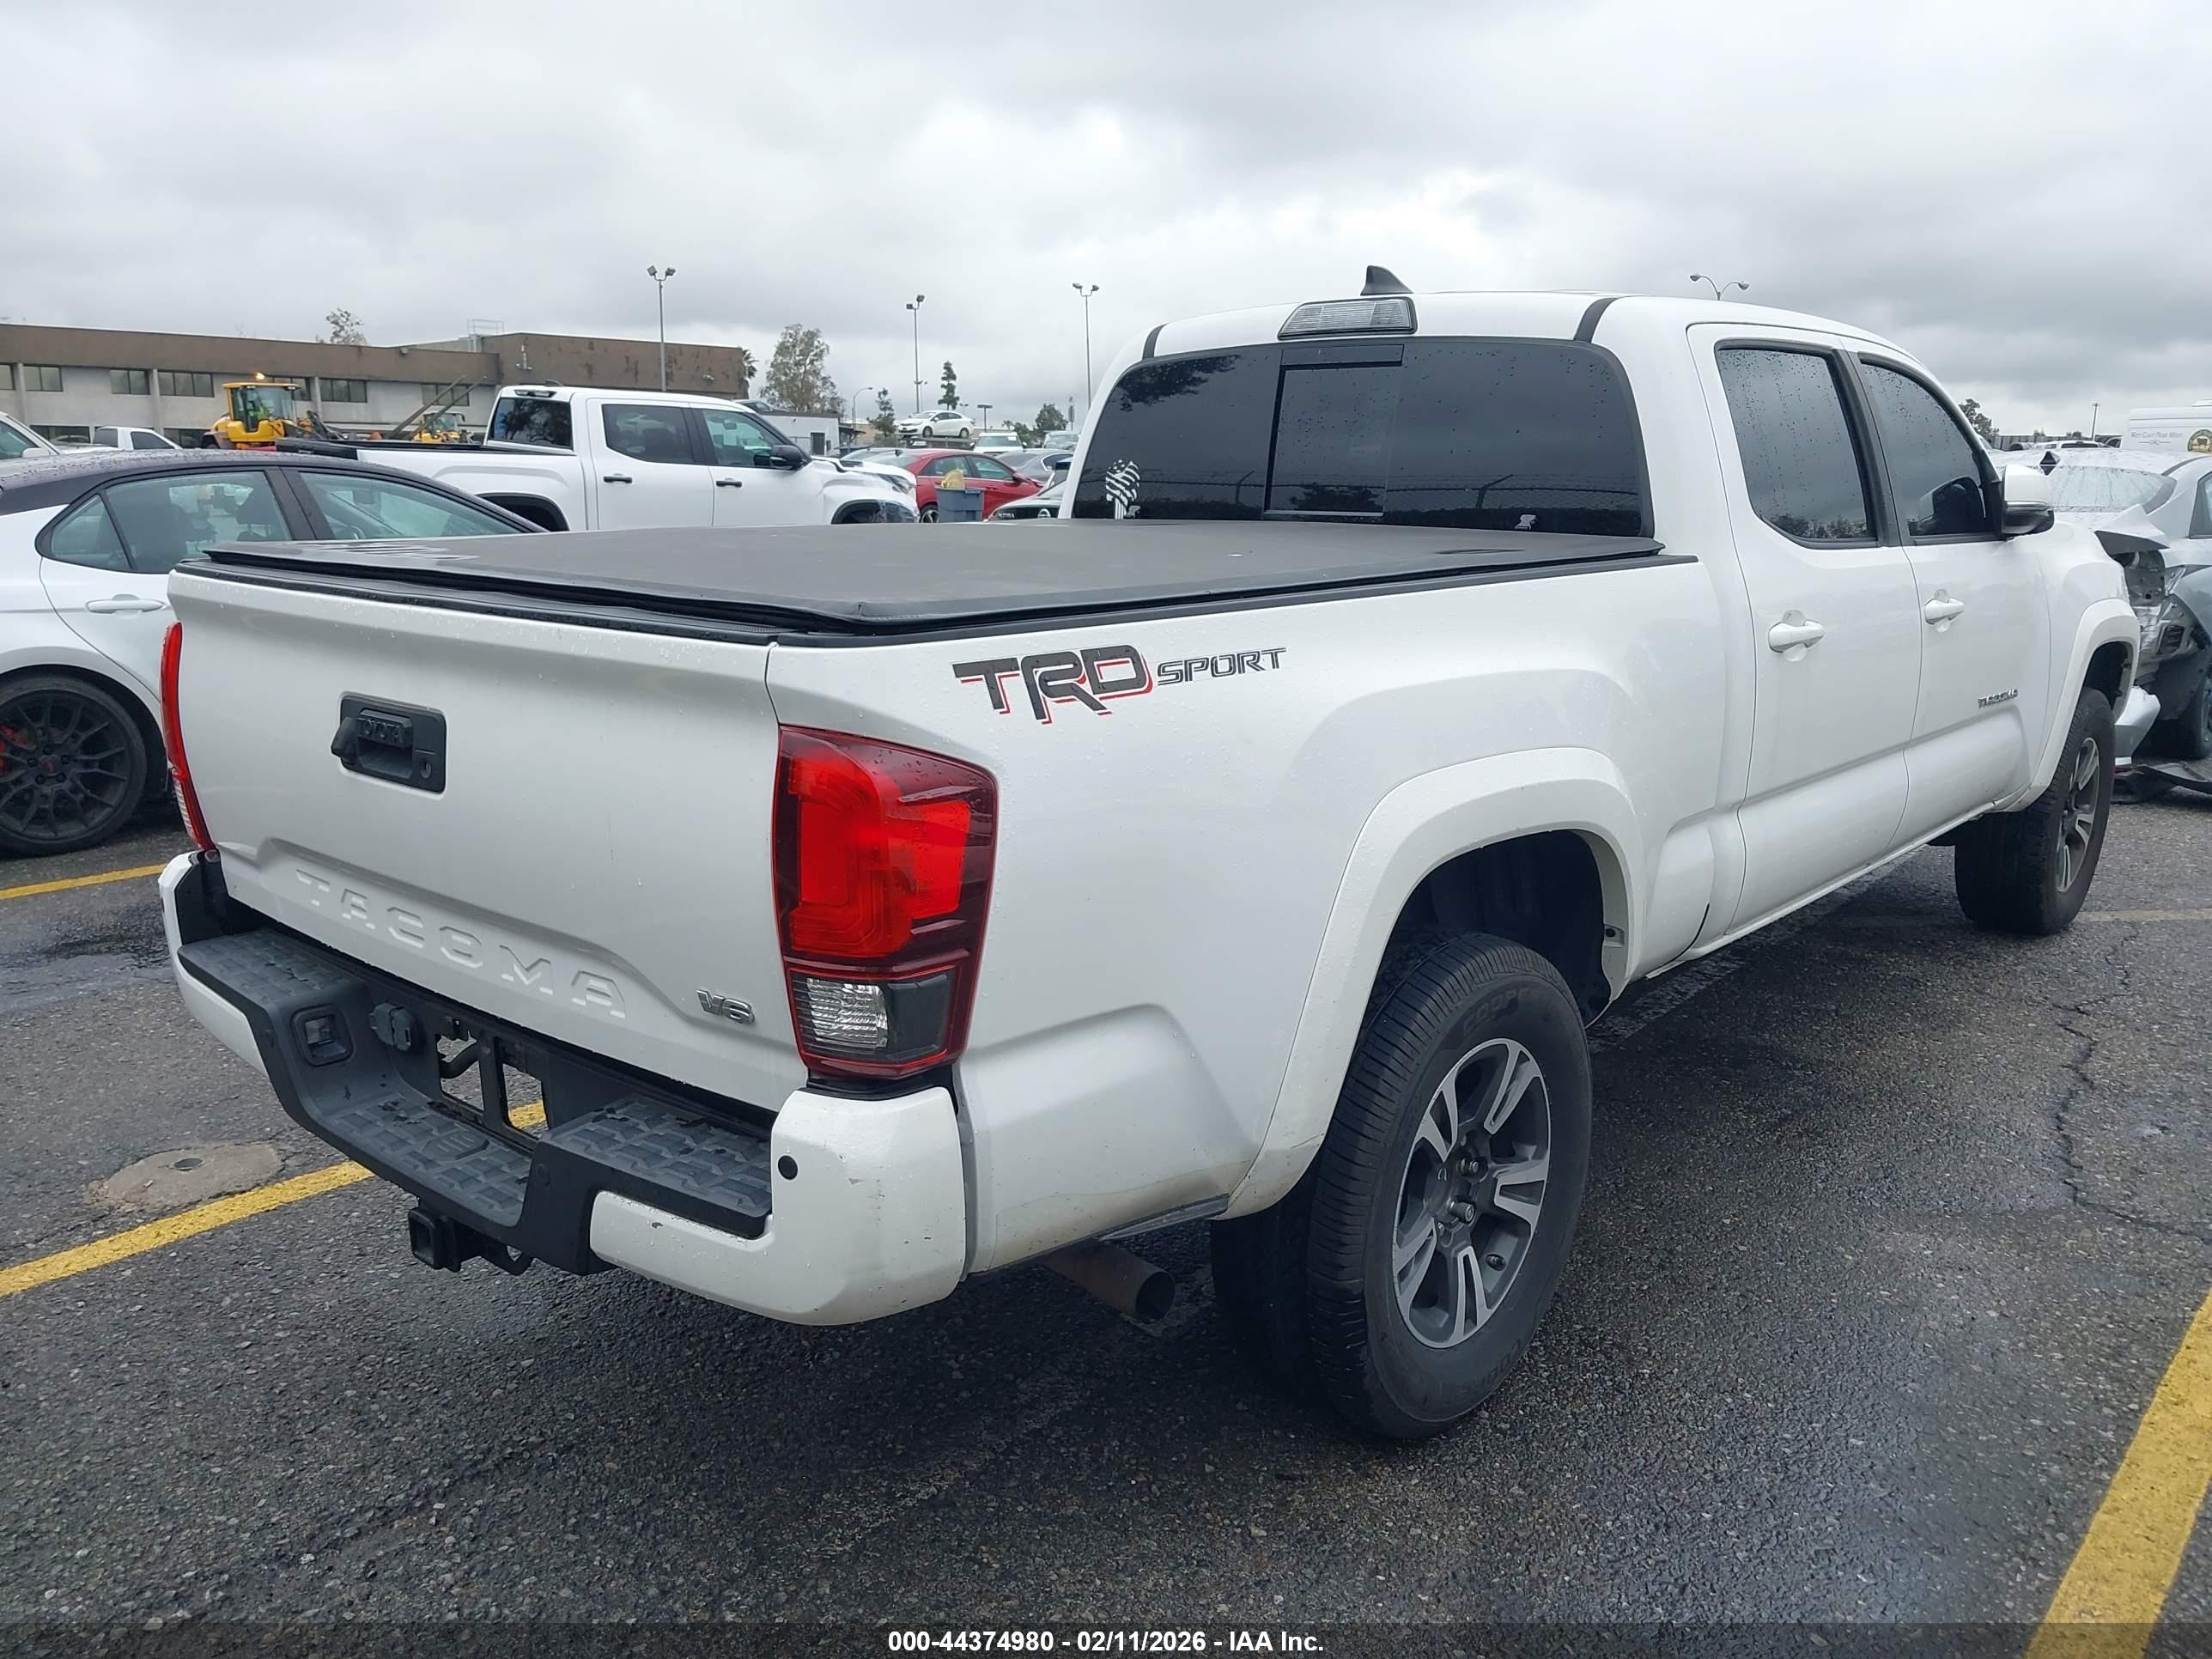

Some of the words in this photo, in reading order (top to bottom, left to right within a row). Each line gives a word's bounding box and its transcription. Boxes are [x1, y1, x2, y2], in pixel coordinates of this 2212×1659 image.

[952, 644, 1153, 724] TRD
[1157, 647, 1287, 686] SPORT
[295, 868, 626, 1019] TACOMA
[696, 988, 756, 1024] V6
